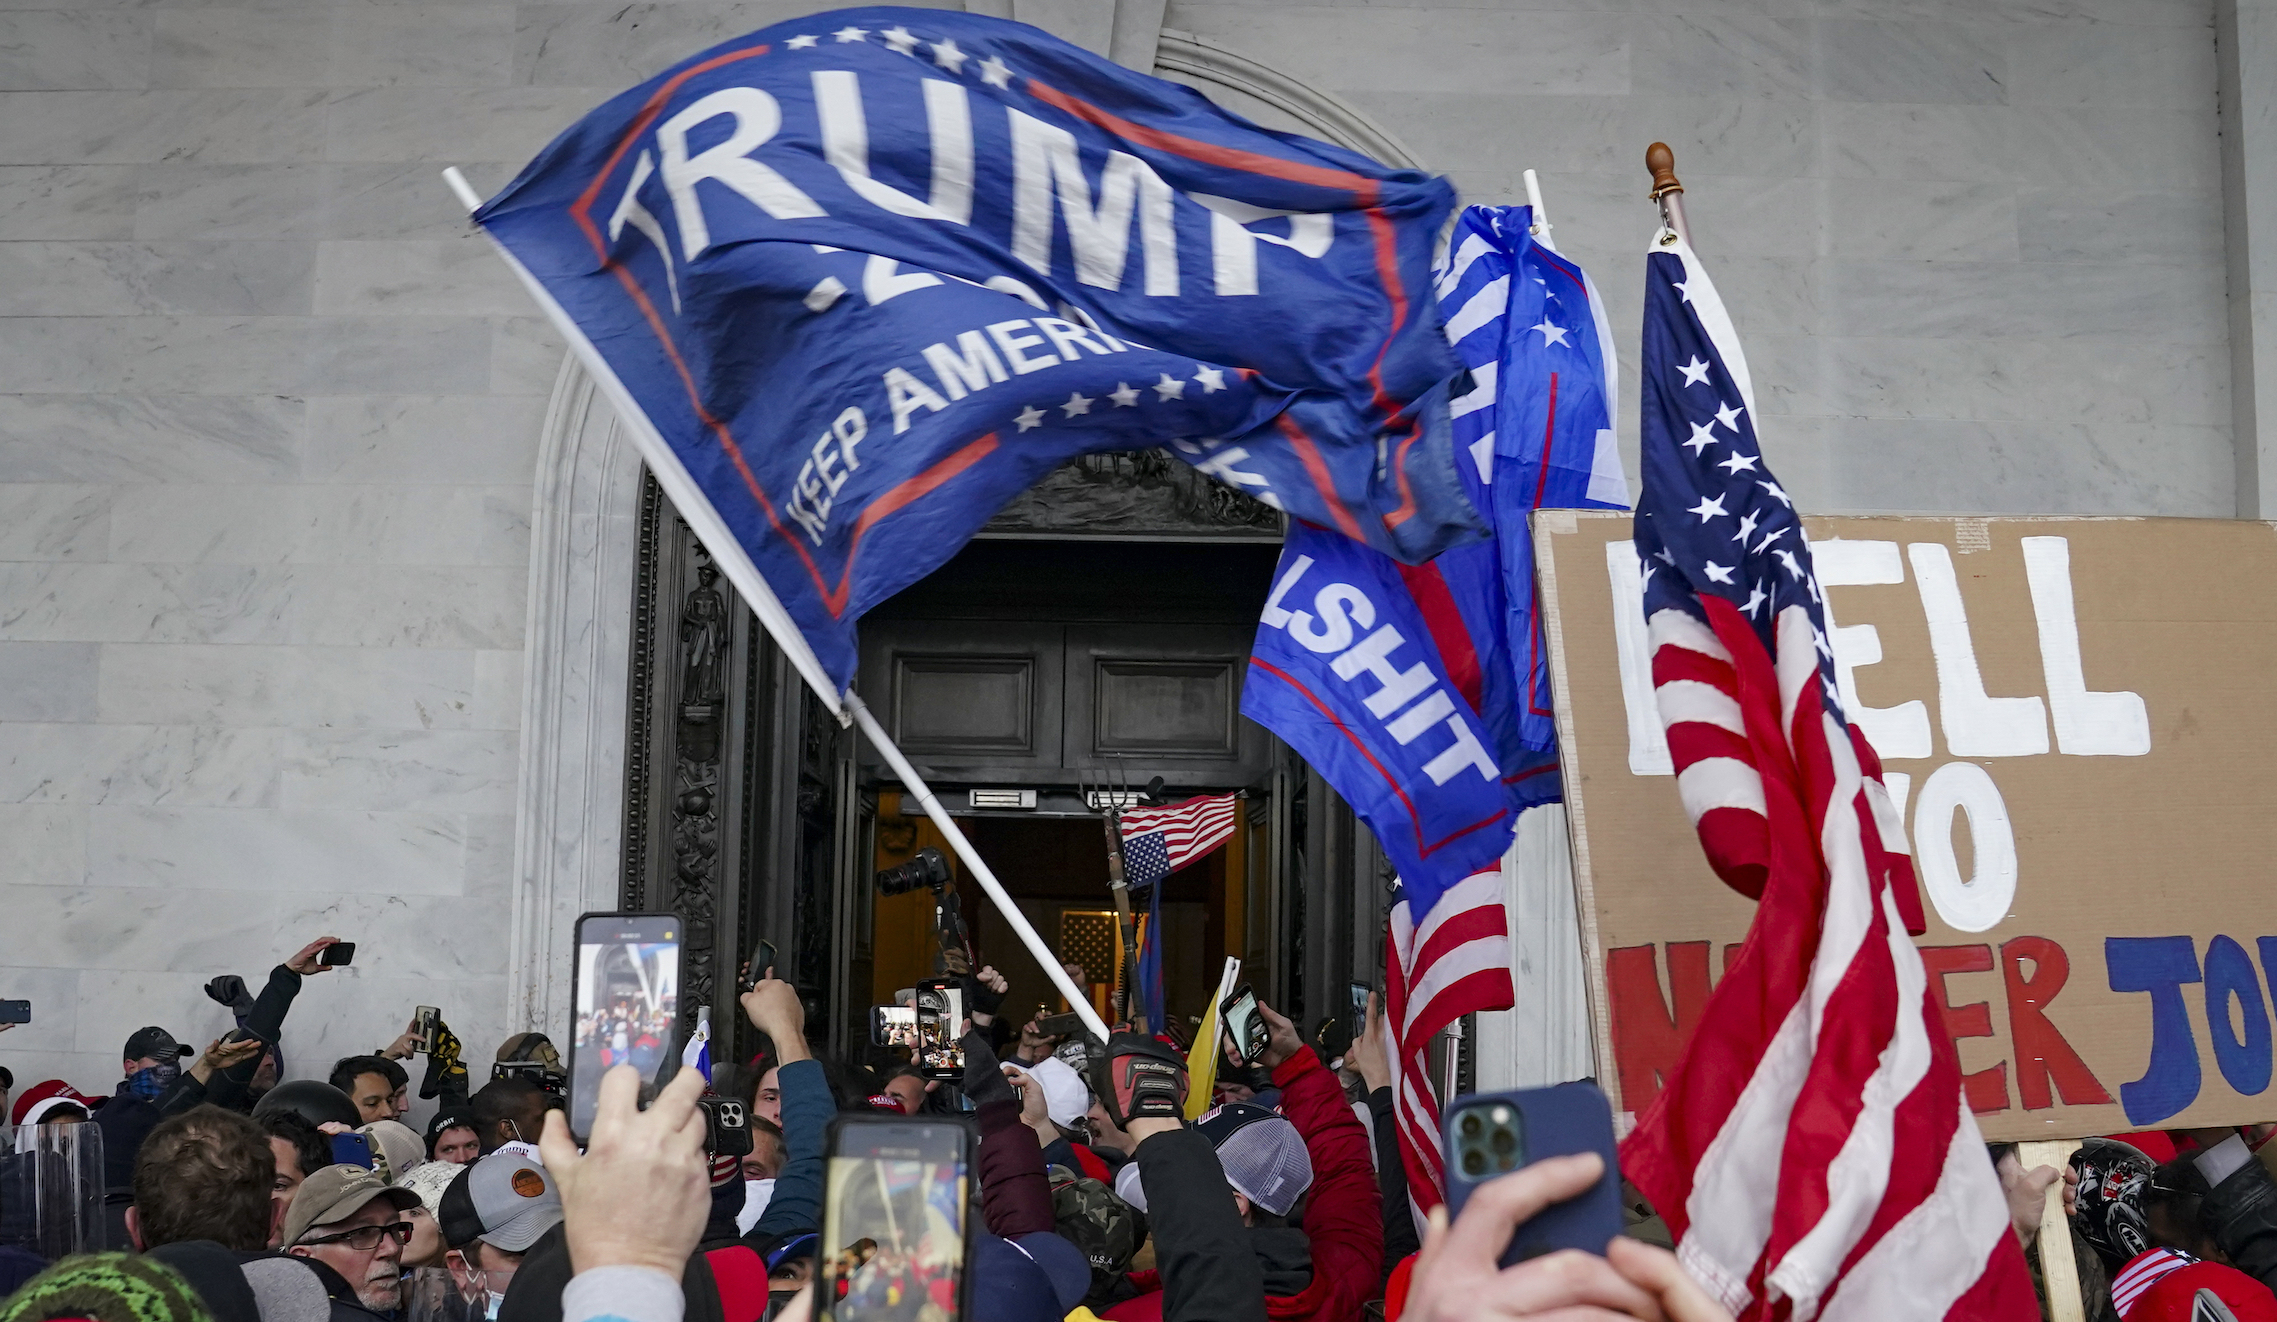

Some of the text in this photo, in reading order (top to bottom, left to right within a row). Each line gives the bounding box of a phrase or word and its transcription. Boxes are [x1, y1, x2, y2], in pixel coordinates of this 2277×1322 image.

[608, 71, 1334, 315] TRUMP
[785, 317, 1130, 547] KEEP AMERI
[1882, 762, 2018, 932] O
[435, 1116, 455, 1132] ORBIT
[1606, 934, 2277, 1126] NER JO
